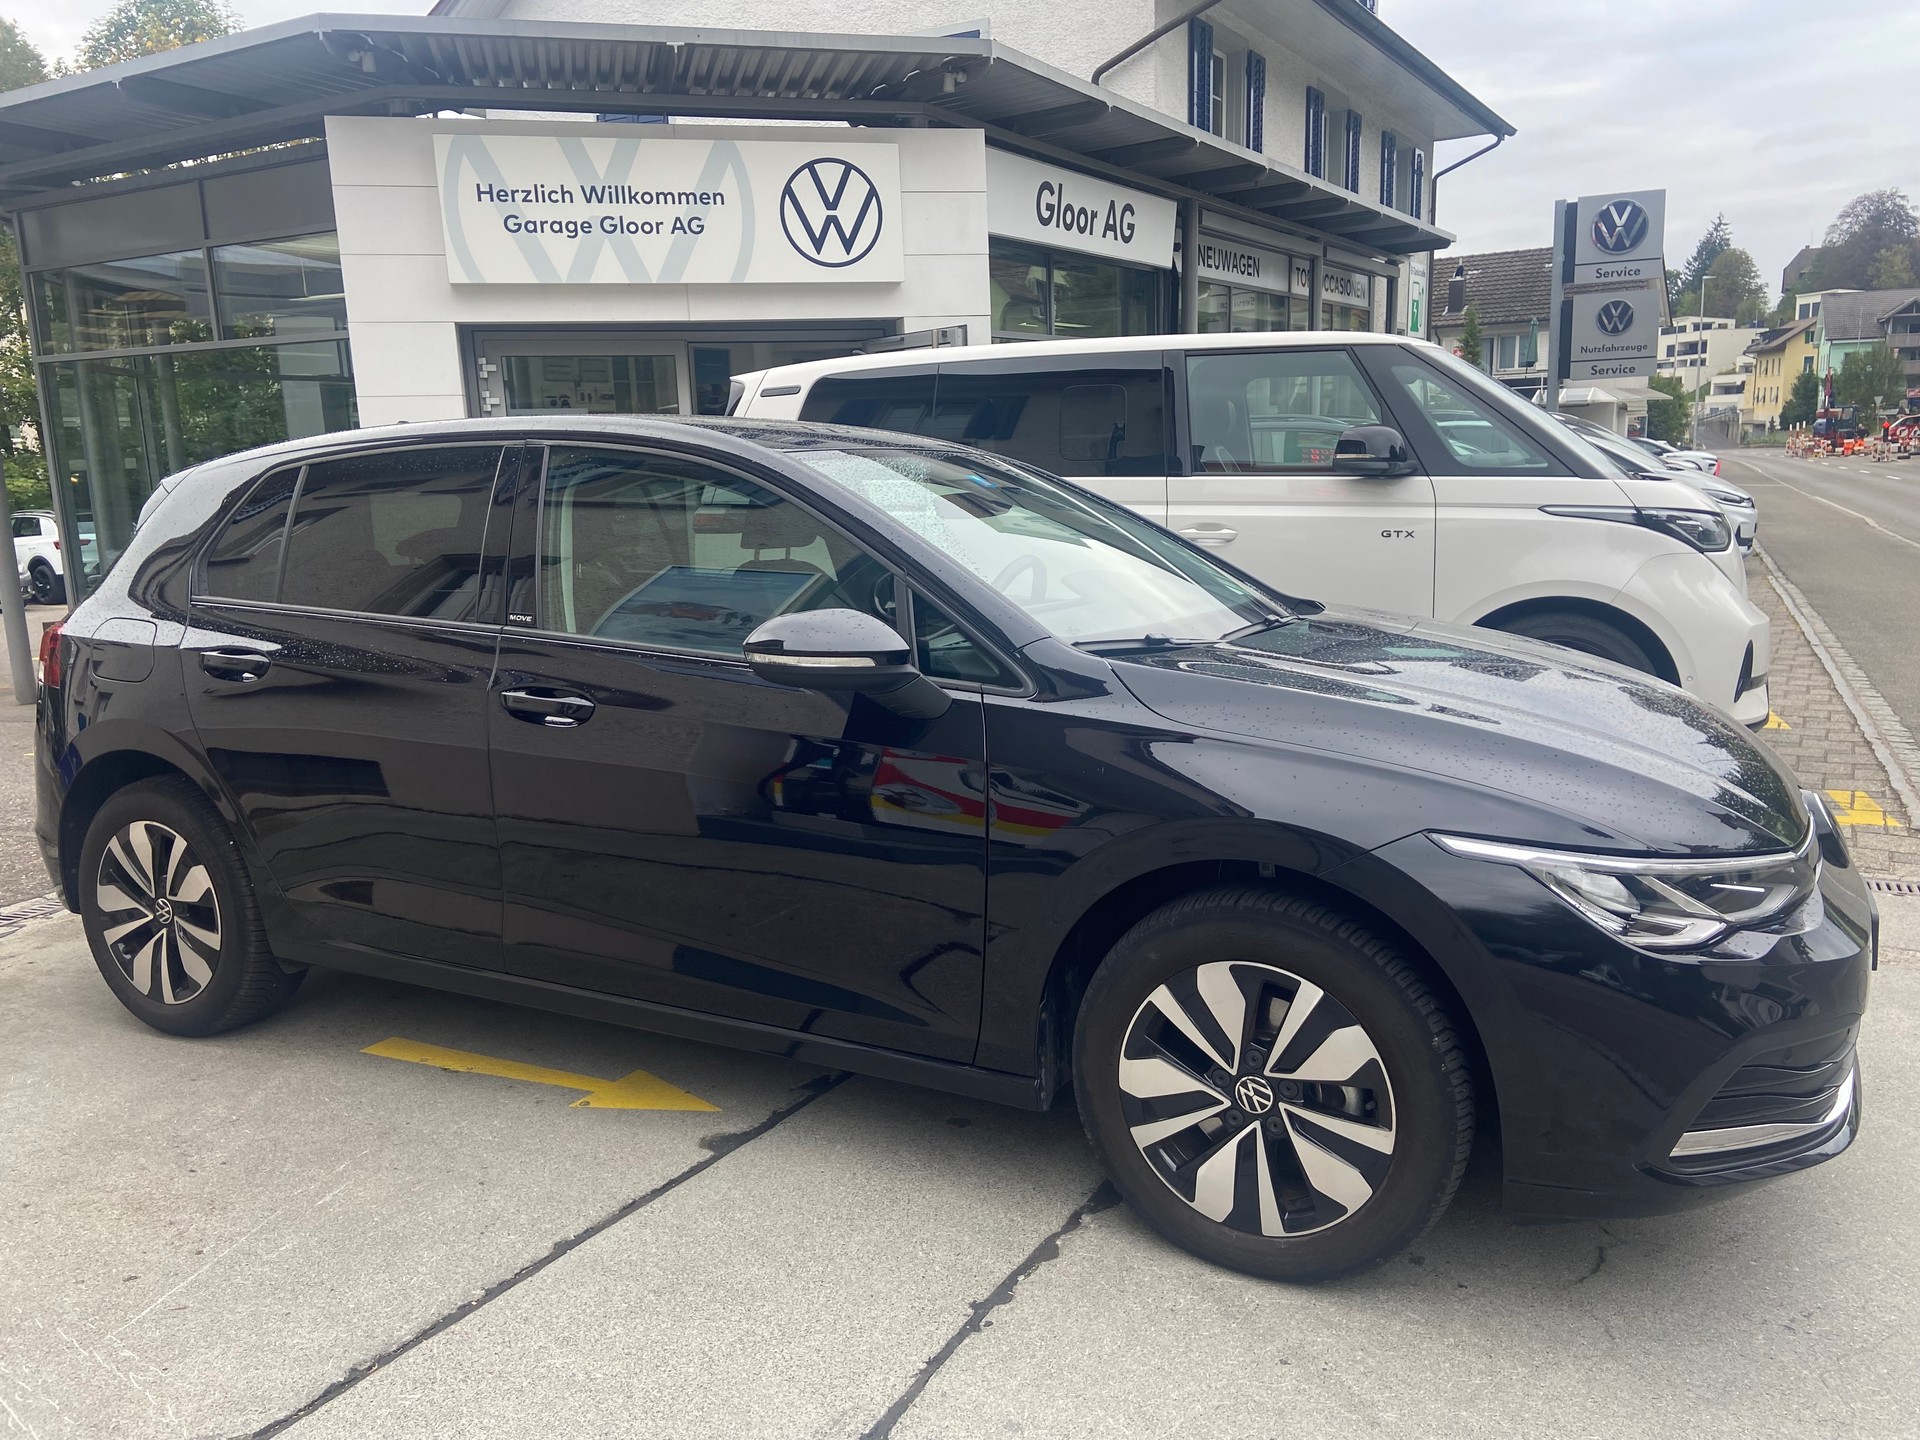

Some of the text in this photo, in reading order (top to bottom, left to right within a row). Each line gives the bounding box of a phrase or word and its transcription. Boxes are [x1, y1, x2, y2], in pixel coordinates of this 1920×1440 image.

[475, 183, 726, 206] Herzlich Willkommen
[1036, 180, 1136, 244] Gloor AG
[503, 214, 705, 239] Garage Gloor AG
[1197, 243, 1260, 279] NEUWAGEN
[1595, 267, 1641, 279] Service
[1321, 273, 1366, 300] CCASIONEN
[1580, 343, 1648, 354] Nutzfahrzeuge
[1590, 364, 1636, 376] Service
[1381, 529, 1416, 539] GTX
[509, 614, 533, 622] MOVE
